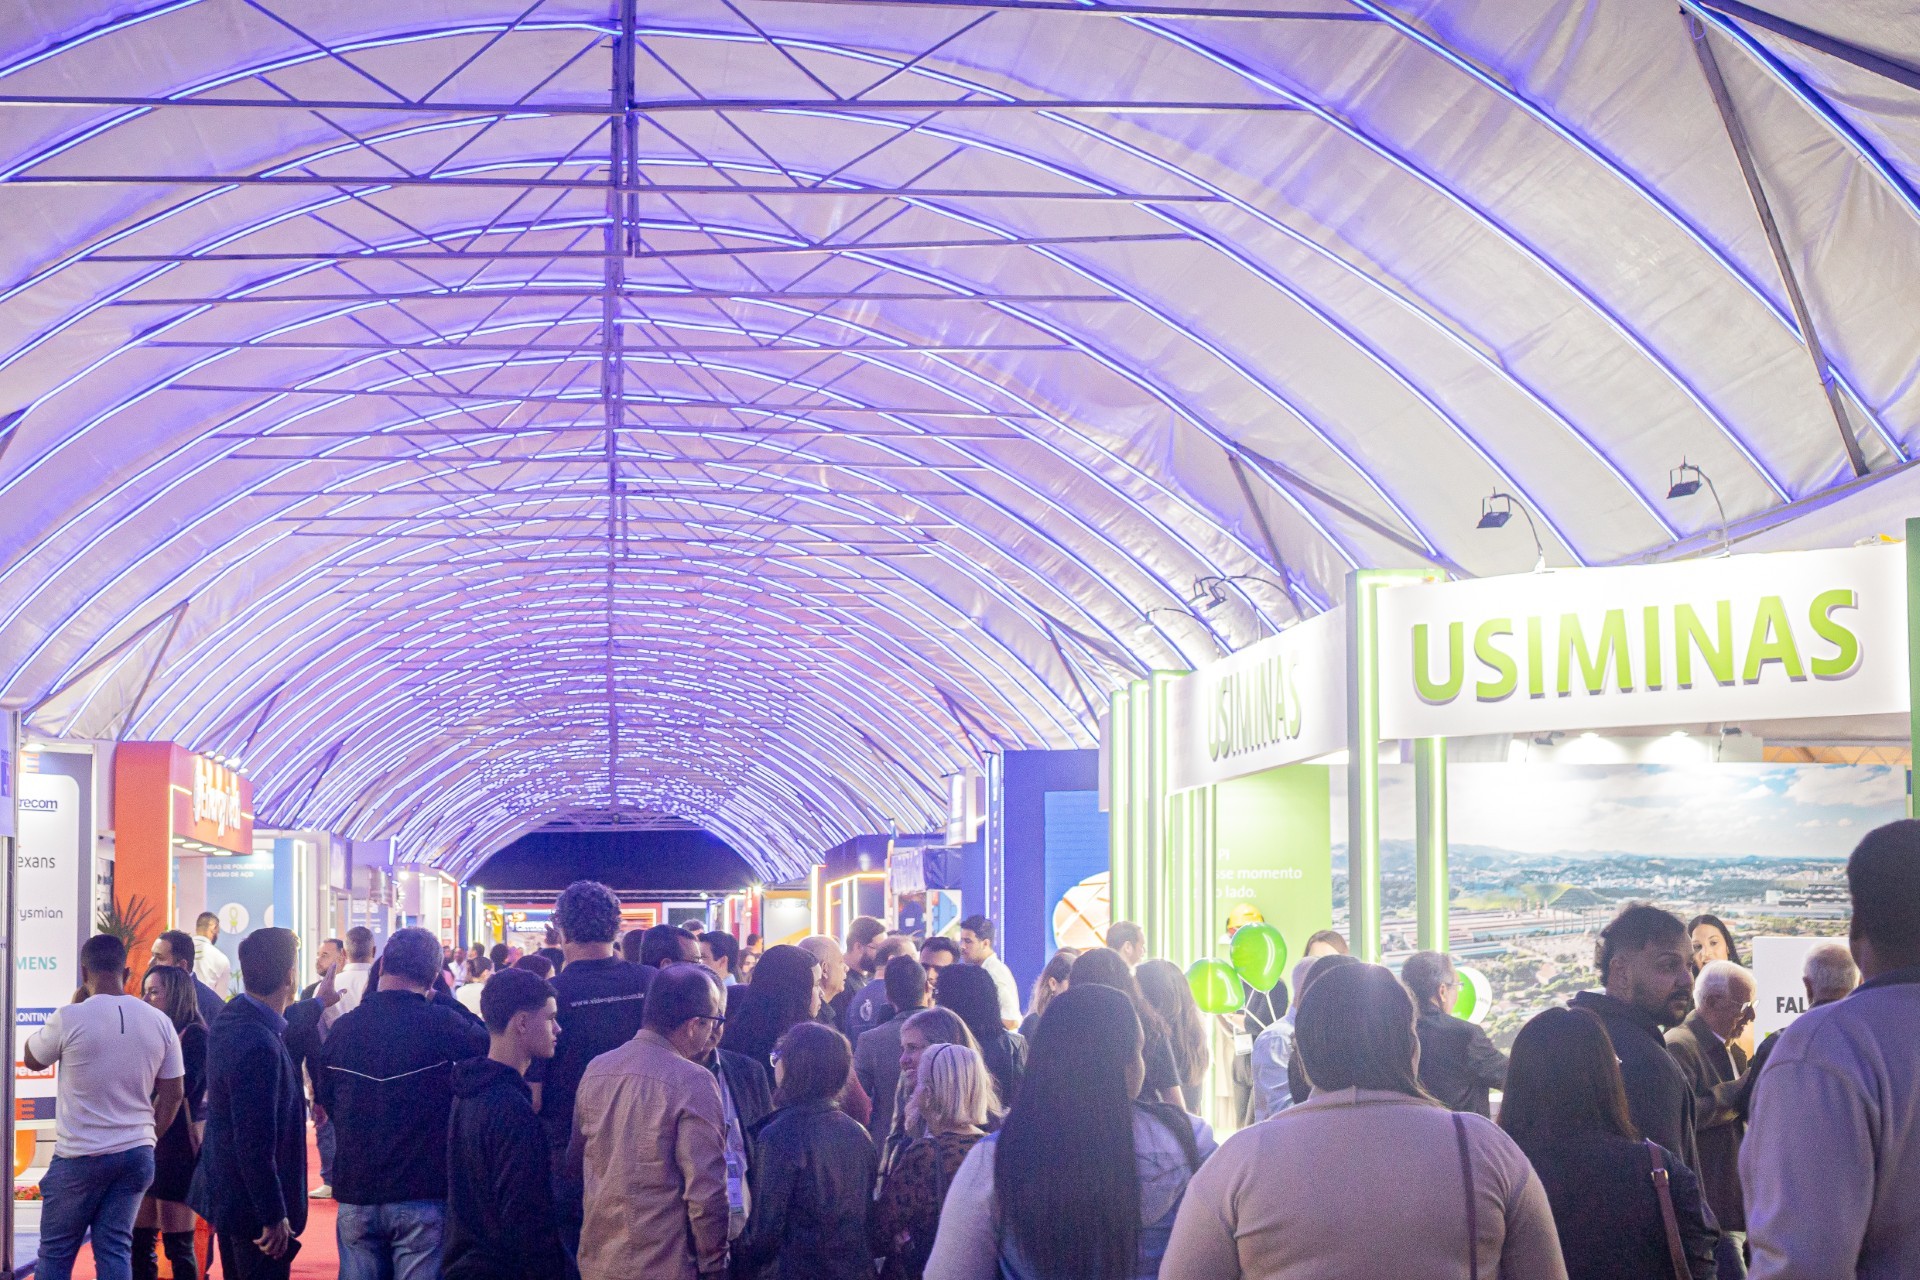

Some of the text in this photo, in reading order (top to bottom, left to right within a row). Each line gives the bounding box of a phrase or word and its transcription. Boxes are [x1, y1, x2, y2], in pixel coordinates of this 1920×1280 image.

[1413, 589, 1861, 704] USIMINAS
[1208, 653, 1301, 761] USIMINAS
[1237, 866, 1303, 880] momento
[1225, 885, 1257, 898] lado.
[18, 906, 63, 921] ysmian
